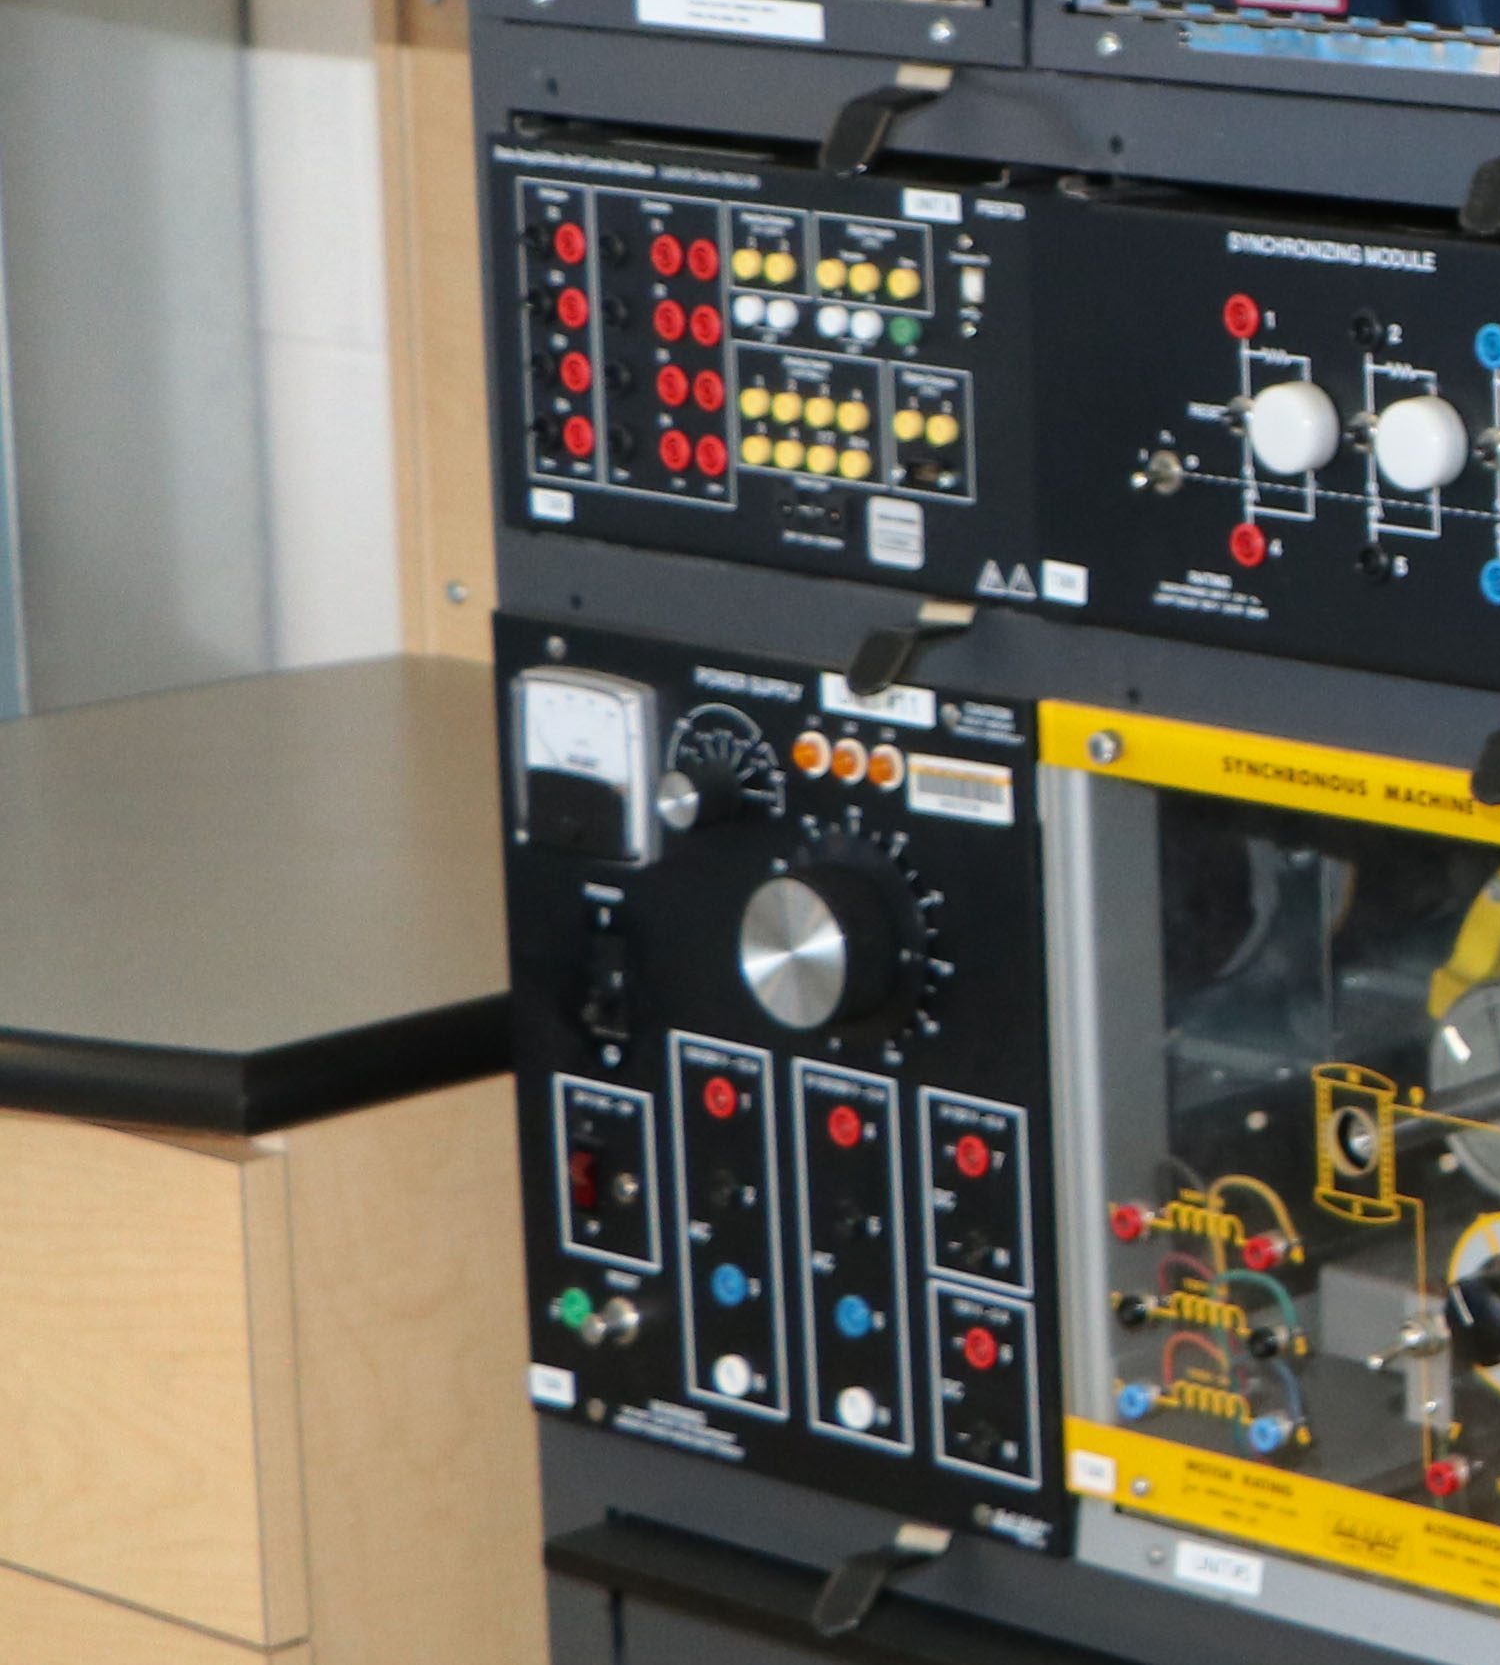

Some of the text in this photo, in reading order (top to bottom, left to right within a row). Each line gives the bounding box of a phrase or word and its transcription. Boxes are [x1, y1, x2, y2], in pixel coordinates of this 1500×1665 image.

[1363, 245, 1437, 273] MODULE
[1386, 323, 1403, 346] 2
[1222, 755, 1476, 816] SYNCHRONOUS MACHINE
